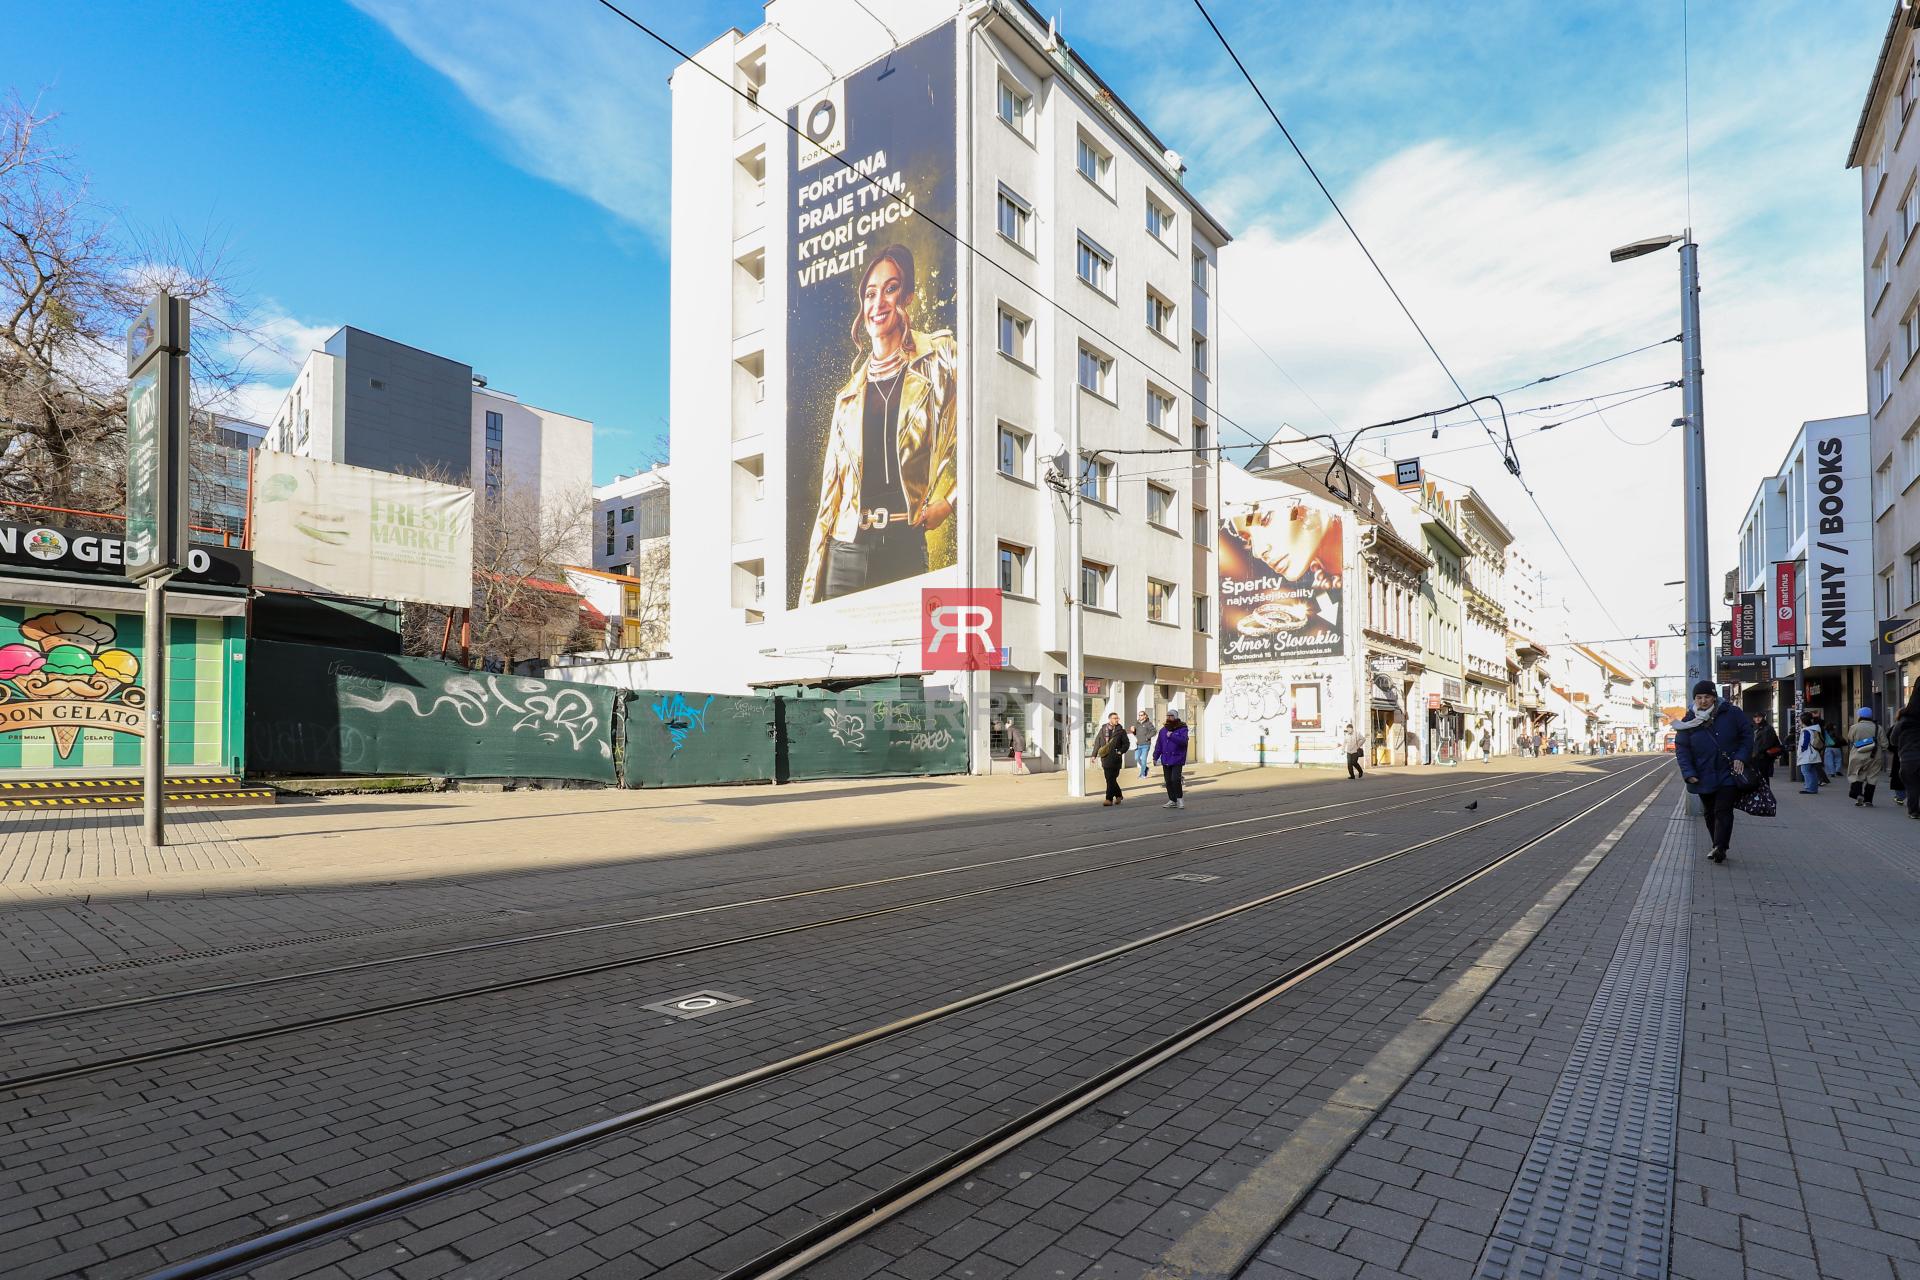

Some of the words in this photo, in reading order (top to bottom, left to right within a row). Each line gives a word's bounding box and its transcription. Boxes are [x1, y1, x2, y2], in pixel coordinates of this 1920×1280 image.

[802, 139, 841, 164] FORTUNA
[799, 151, 887, 207] FORTUNA
[799, 193, 854, 234] PRAJE
[857, 171, 906, 207] TÝM,
[799, 217, 853, 261] KTORÍ
[856, 192, 915, 236] CHCÚ
[798, 241, 868, 288] VÍŤAZIŤ
[1818, 438, 1844, 534] BOOKS
[1221, 576, 1283, 596] Šperky
[1226, 592, 1275, 606] najvyššej
[1821, 563, 1846, 647] KNIHY
[1224, 635, 1271, 655] Amor
[1273, 630, 1341, 651] Slovakia
[1723, 630, 1731, 656] OXFORD
[52, 705, 139, 726] GELATO
